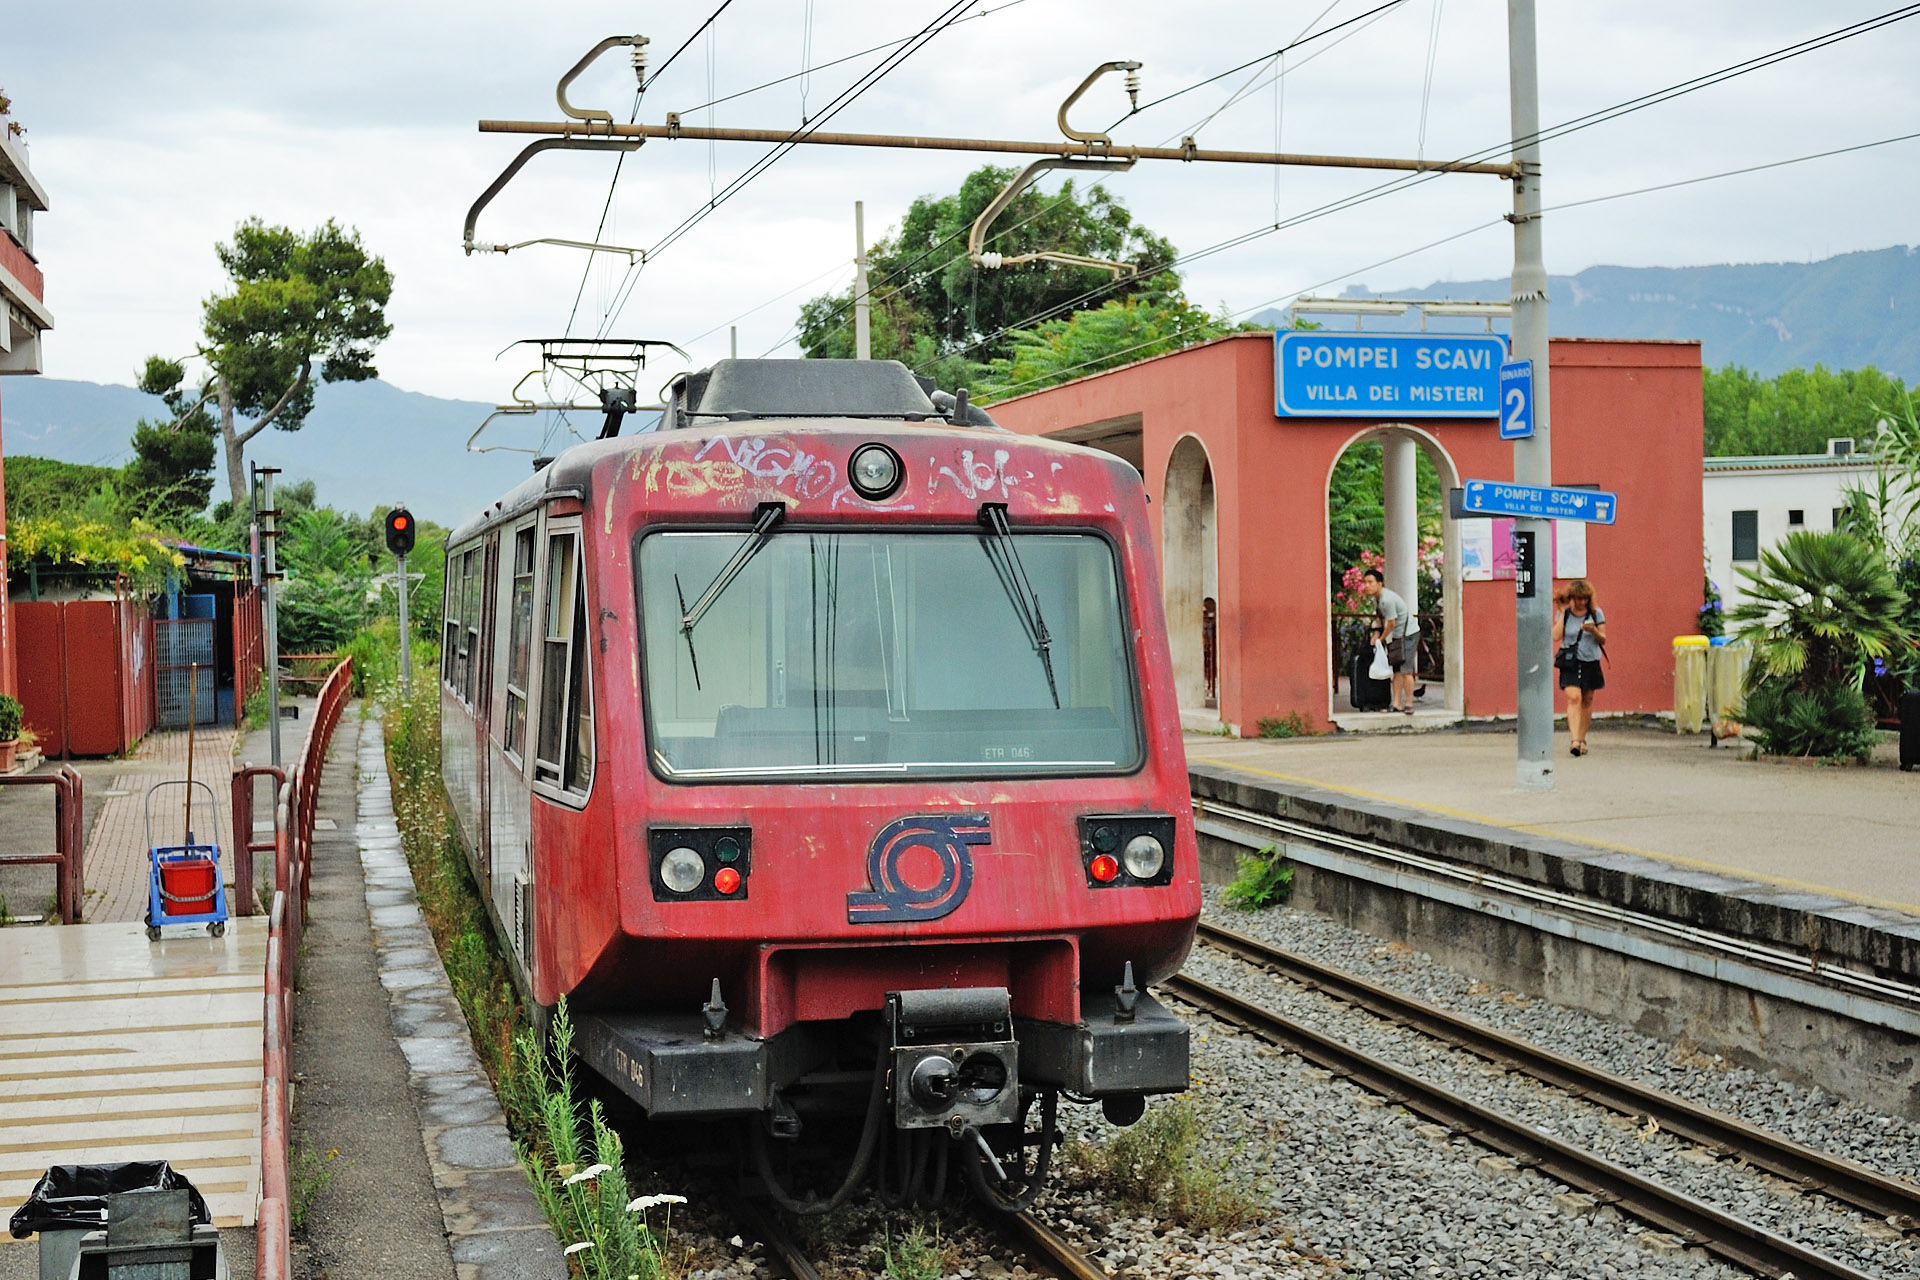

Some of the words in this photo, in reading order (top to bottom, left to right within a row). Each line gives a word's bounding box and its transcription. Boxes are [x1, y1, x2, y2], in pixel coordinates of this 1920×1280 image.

[1296, 346, 1398, 369] POMPEI
[1415, 348, 1491, 370] SCAVI
[1502, 368, 1531, 381] BINARIO
[1306, 384, 1358, 401] VILLA
[1369, 385, 1399, 401] DEI
[1410, 386, 1484, 402] MISTERI
[1506, 388, 1526, 431] 2
[1494, 487, 1542, 502] POMPEI
[1504, 502, 1526, 511] VILLA
[1530, 504, 1543, 513] DEI
[1546, 506, 1577, 516] MISTERI
[985, 747, 1005, 760] ETR
[1011, 747, 1030, 759] 046
[630, 1059, 644, 1088] 046
